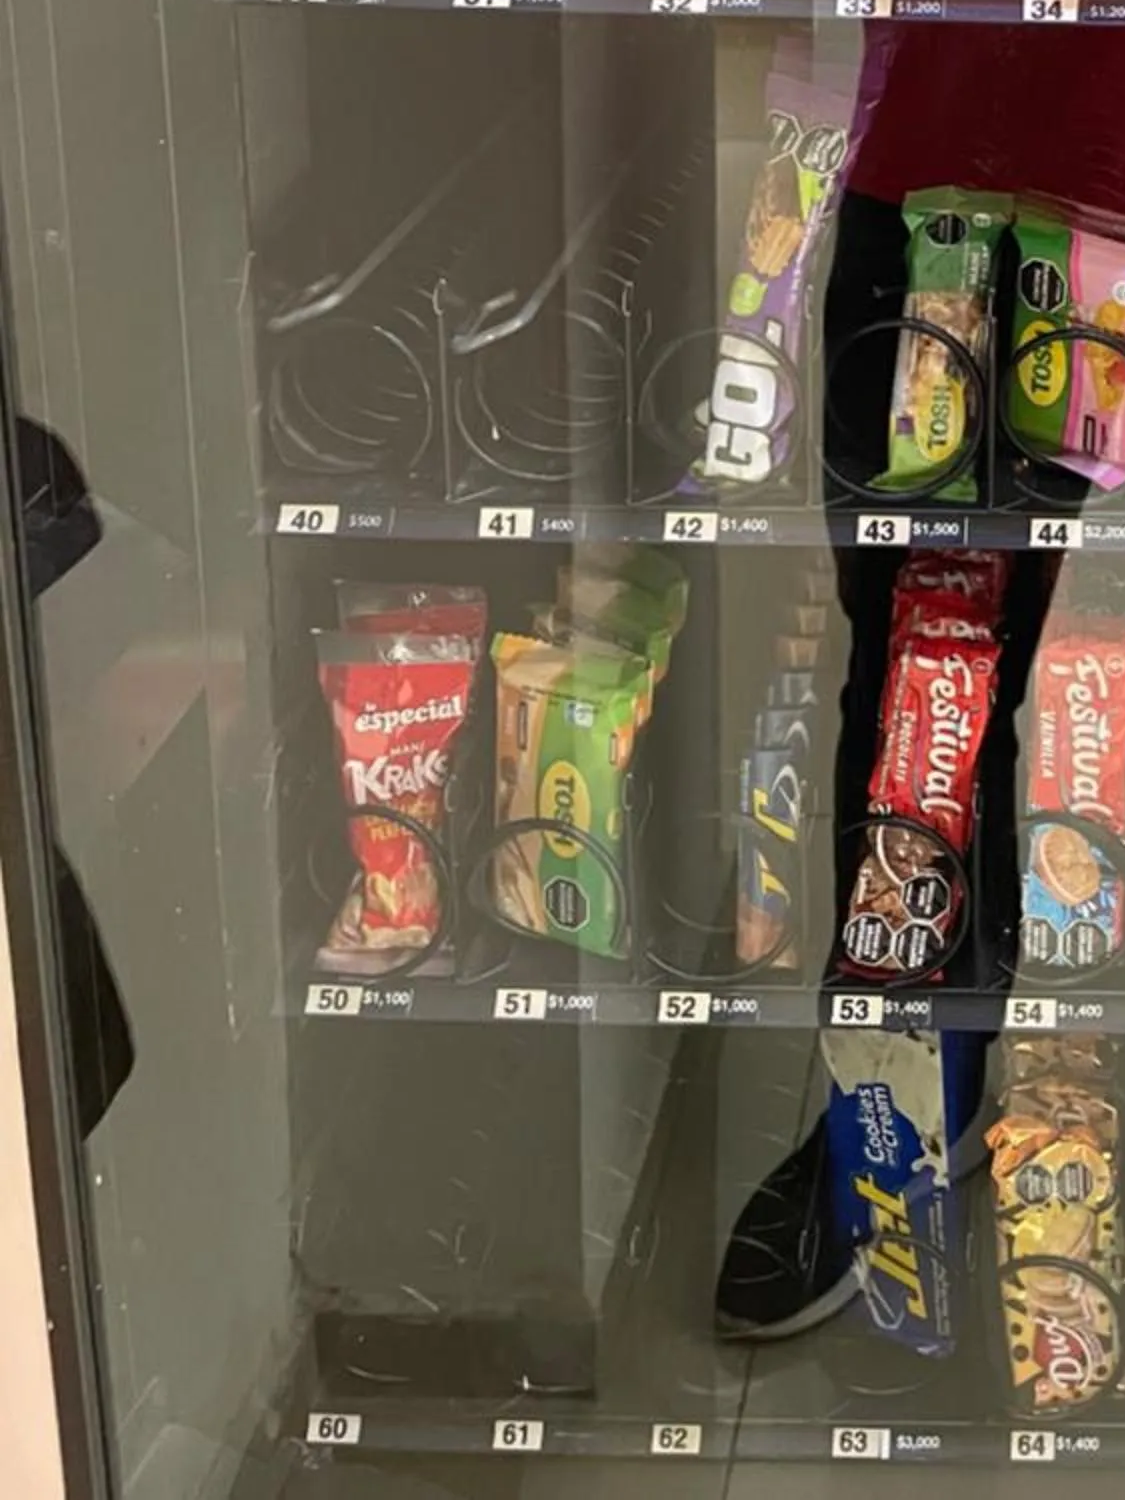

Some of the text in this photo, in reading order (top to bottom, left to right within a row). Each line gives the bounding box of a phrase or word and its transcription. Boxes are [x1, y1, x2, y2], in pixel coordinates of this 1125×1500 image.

[1030, 0, 1062, 19] 34
[703, 321, 783, 483] GOL
[926, 382, 952, 449] TOSH
[290, 511, 323, 531] 40
[488, 513, 517, 534] 41
[672, 518, 703, 538] 42
[720, 518, 768, 533] $1,400
[864, 520, 895, 541] 43
[912, 523, 959, 536] $1,500
[1037, 525, 1069, 545] 44
[915, 653, 973, 814] Festival
[1049, 653, 1114, 819] Festival
[1039, 709, 1056, 780] VAINILLA
[319, 989, 348, 1010] 50
[363, 991, 410, 1007] $1,100
[504, 992, 533, 1013] 51
[549, 995, 593, 1010] $1,000
[667, 996, 696, 1018] 52
[712, 999, 758, 1013] $1,000
[884, 1001, 929, 1015] $1,400
[838, 999, 868, 1021] 53
[1013, 1003, 1043, 1023] 54
[1058, 1003, 1103, 1018] $1,400
[857, 1087, 883, 1162] Cookies
[855, 1171, 928, 1320] Jet
[1033, 1314, 1085, 1389] Dux
[319, 1417, 347, 1439] 60
[503, 1423, 529, 1445] 61
[659, 1428, 688, 1449] 62
[840, 1432, 868, 1453] 63
[1017, 1435, 1046, 1456] 64
[1056, 1437, 1099, 1452] $1,400
